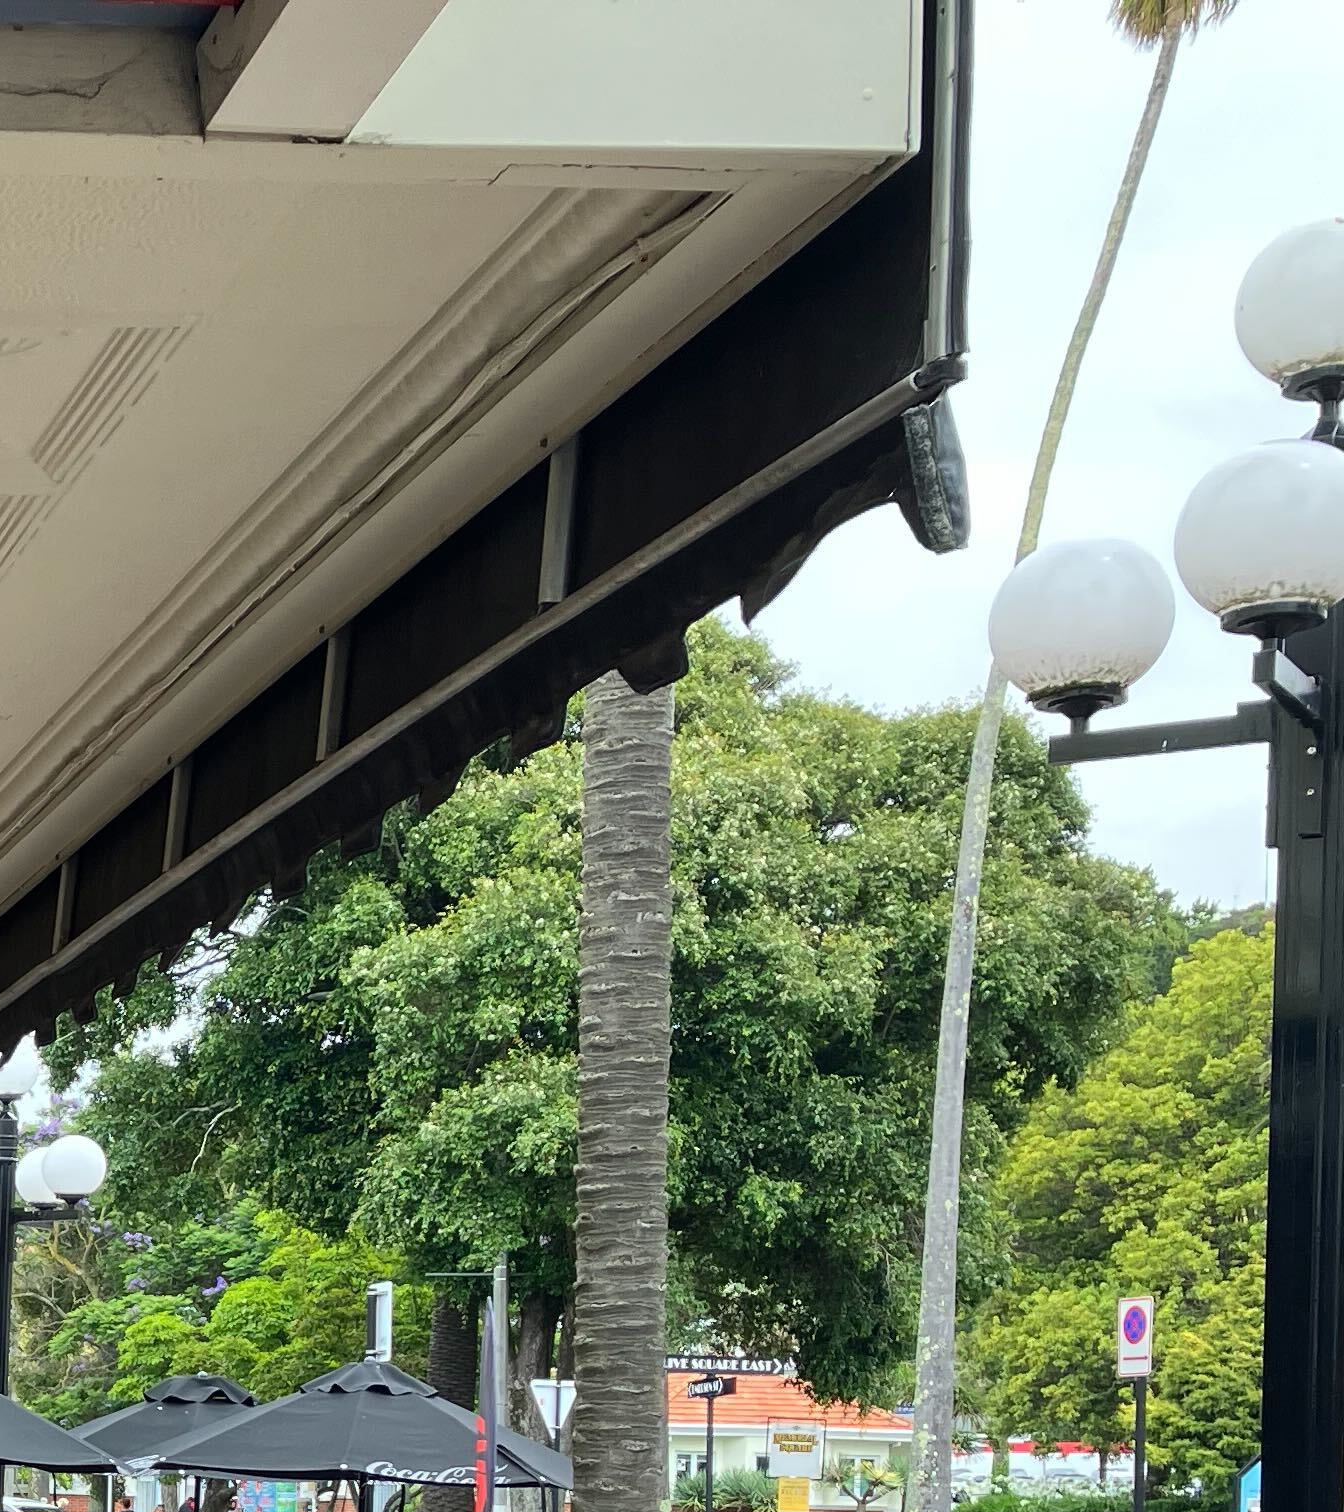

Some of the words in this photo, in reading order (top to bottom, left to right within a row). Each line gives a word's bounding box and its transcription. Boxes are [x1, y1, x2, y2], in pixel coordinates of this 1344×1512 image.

[691, 1358, 740, 1371] SQUARE
[741, 1359, 773, 1372] EAST
[365, 1460, 512, 1484] Coca-Coa
